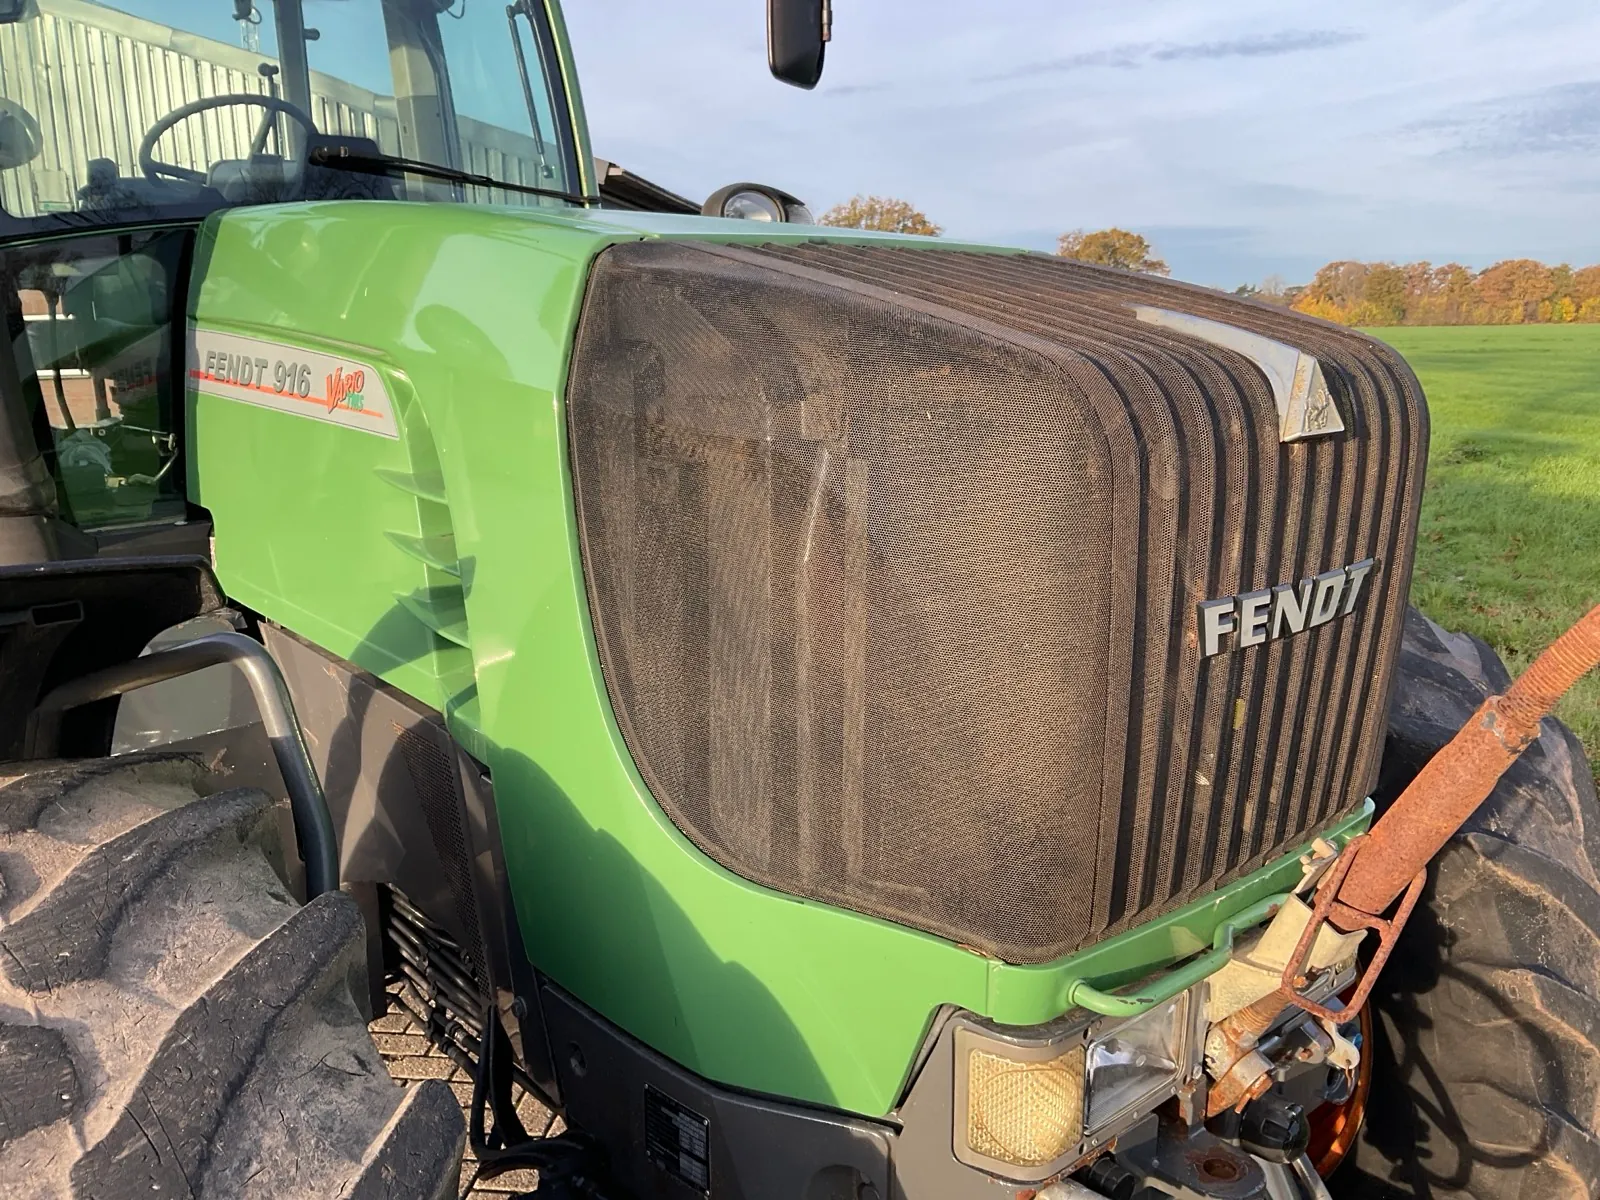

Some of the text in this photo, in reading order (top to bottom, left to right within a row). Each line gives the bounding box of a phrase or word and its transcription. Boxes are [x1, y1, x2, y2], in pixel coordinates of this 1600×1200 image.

[205, 351, 268, 389] FENDT
[273, 360, 311, 398] 916
[1198, 557, 1374, 658] FENDT
